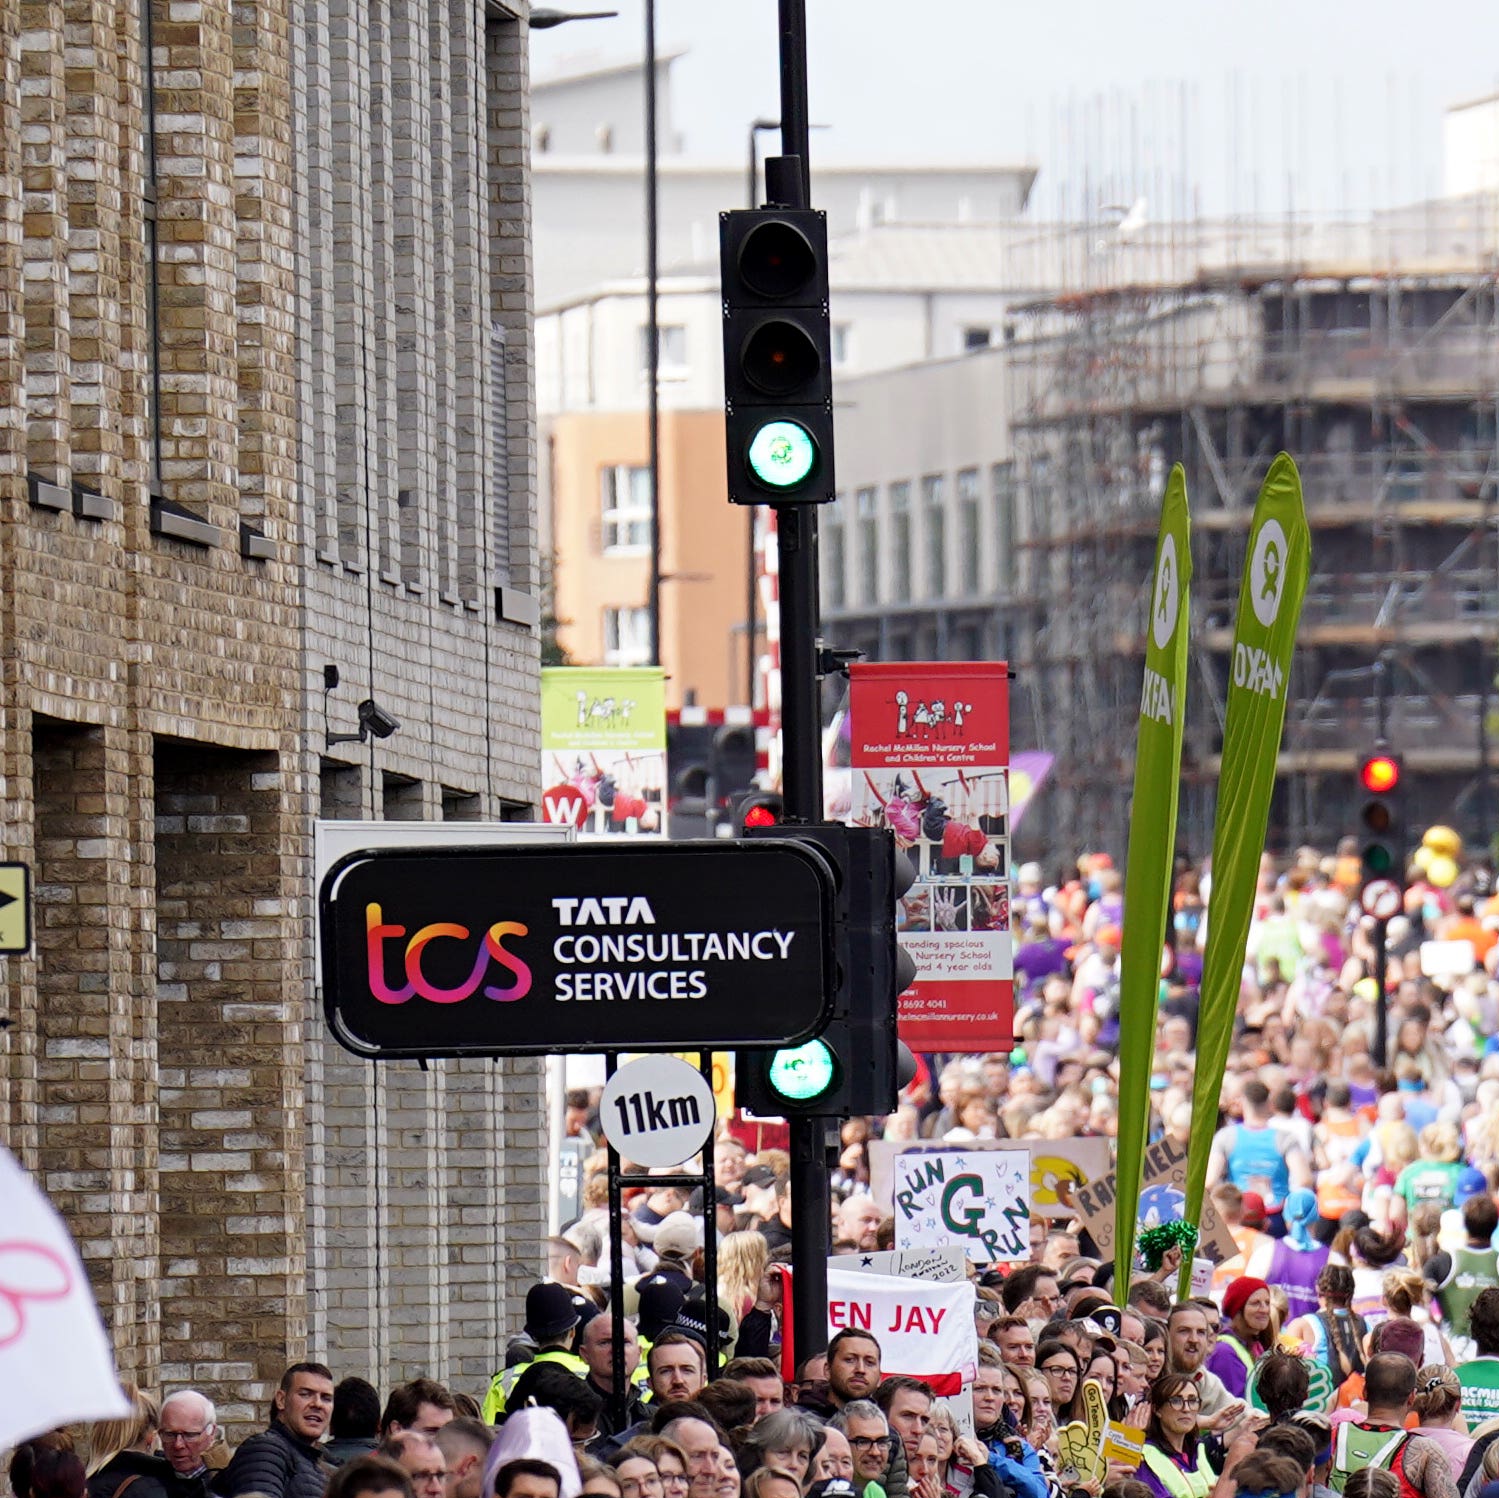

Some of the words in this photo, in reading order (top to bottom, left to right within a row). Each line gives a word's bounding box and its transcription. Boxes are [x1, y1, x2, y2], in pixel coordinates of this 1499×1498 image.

[1140, 667, 1177, 725] XFA
[863, 744, 892, 752] Rachel
[893, 744, 930, 752] McMillan
[932, 744, 966, 754] Nursery
[969, 743, 996, 751] School
[885, 754, 901, 762] and
[902, 753, 944, 762] Children's
[552, 896, 656, 926] TATA
[366, 902, 532, 1005] tcs
[552, 931, 796, 964] CONSULTANCY
[901, 940, 940, 950] standing
[944, 940, 984, 949] spacious
[916, 952, 955, 961] Nursery
[960, 951, 991, 960] School
[947, 964, 969, 973] year
[554, 970, 708, 1002] SERVICES
[903, 1000, 925, 1008] 8692
[926, 1000, 947, 1008] 4041
[614, 1091, 700, 1136] 11km
[897, 1157, 945, 1220] RUN
[941, 1173, 985, 1238] G
[981, 1196, 1030, 1263] RUN
[931, 1264, 958, 1281] 2022
[888, 1304, 947, 1335] JAY
[1088, 1388, 1096, 1402] Go
[1091, 1403, 1100, 1428] Team
